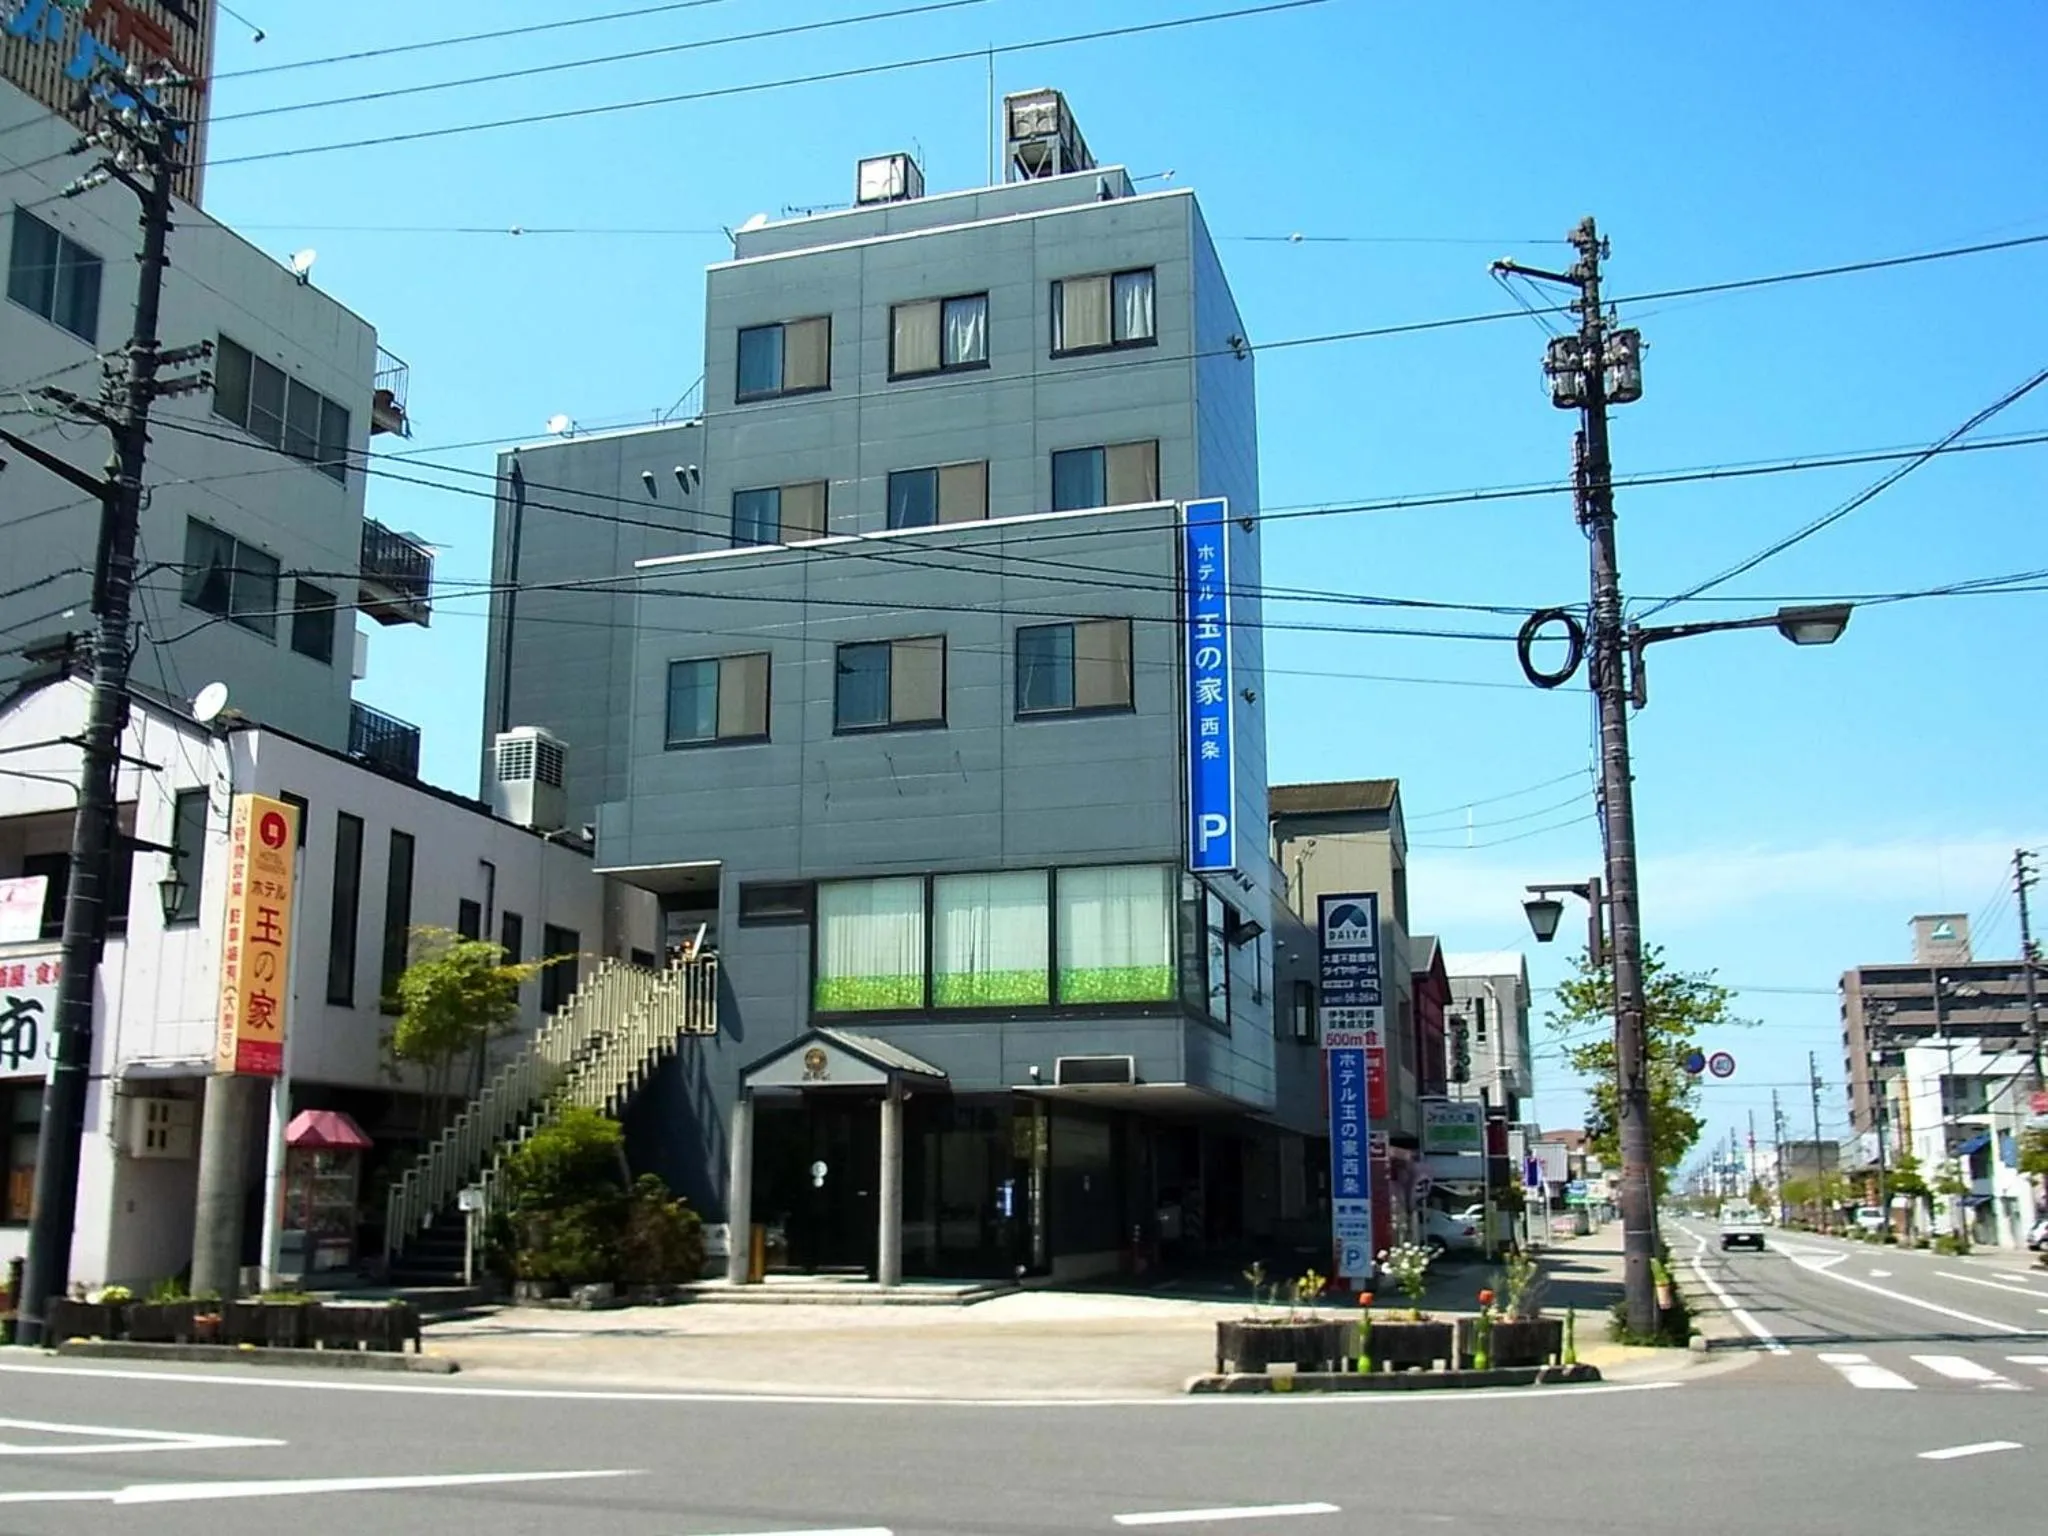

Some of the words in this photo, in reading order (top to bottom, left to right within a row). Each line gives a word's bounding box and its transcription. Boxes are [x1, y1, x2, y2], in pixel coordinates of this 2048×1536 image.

[1199, 813, 1228, 853] P
[251, 879, 287, 900] ホテル
[1328, 929, 1368, 940] DAIYA
[246, 905, 283, 1030] 玉の家
[1346, 1248, 1360, 1267] P
